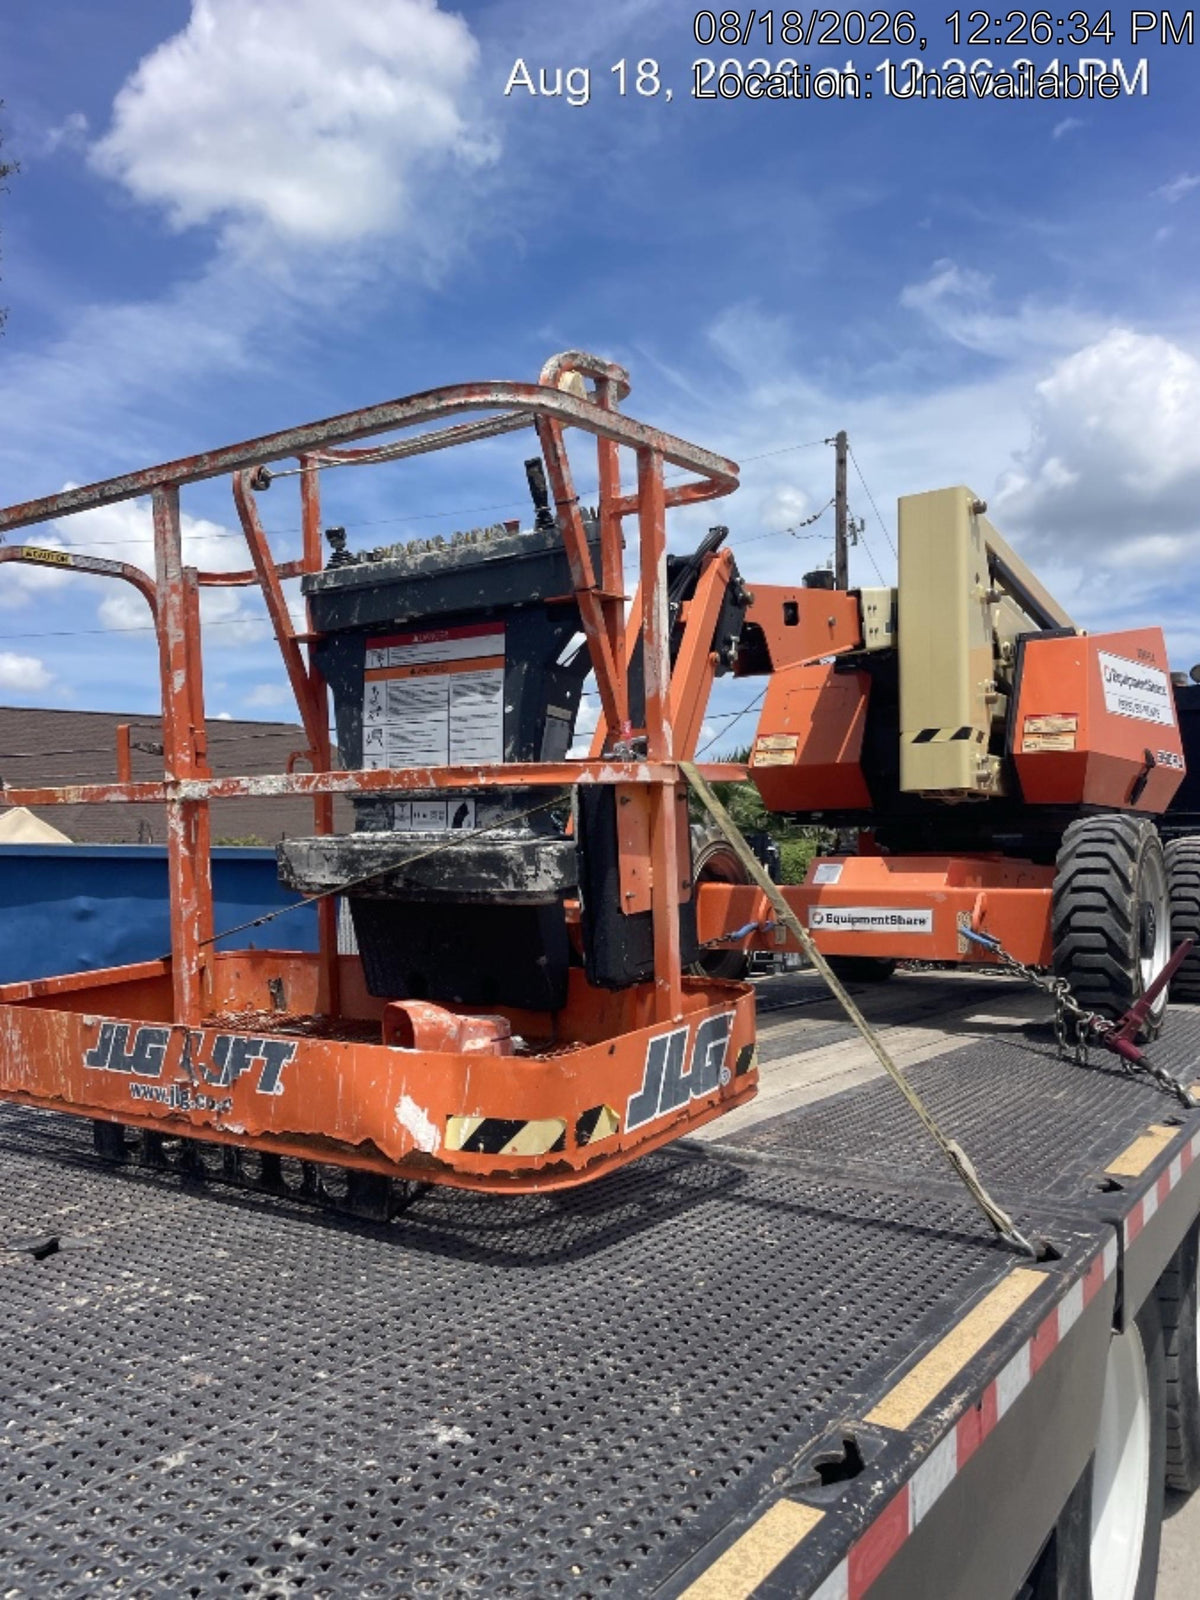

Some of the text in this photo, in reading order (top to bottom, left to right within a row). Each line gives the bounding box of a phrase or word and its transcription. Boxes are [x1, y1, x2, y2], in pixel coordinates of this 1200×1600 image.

[825, 912, 928, 927] EquipmentShare
[83, 1021, 172, 1079] JLG
[623, 1009, 736, 1135] JLG
